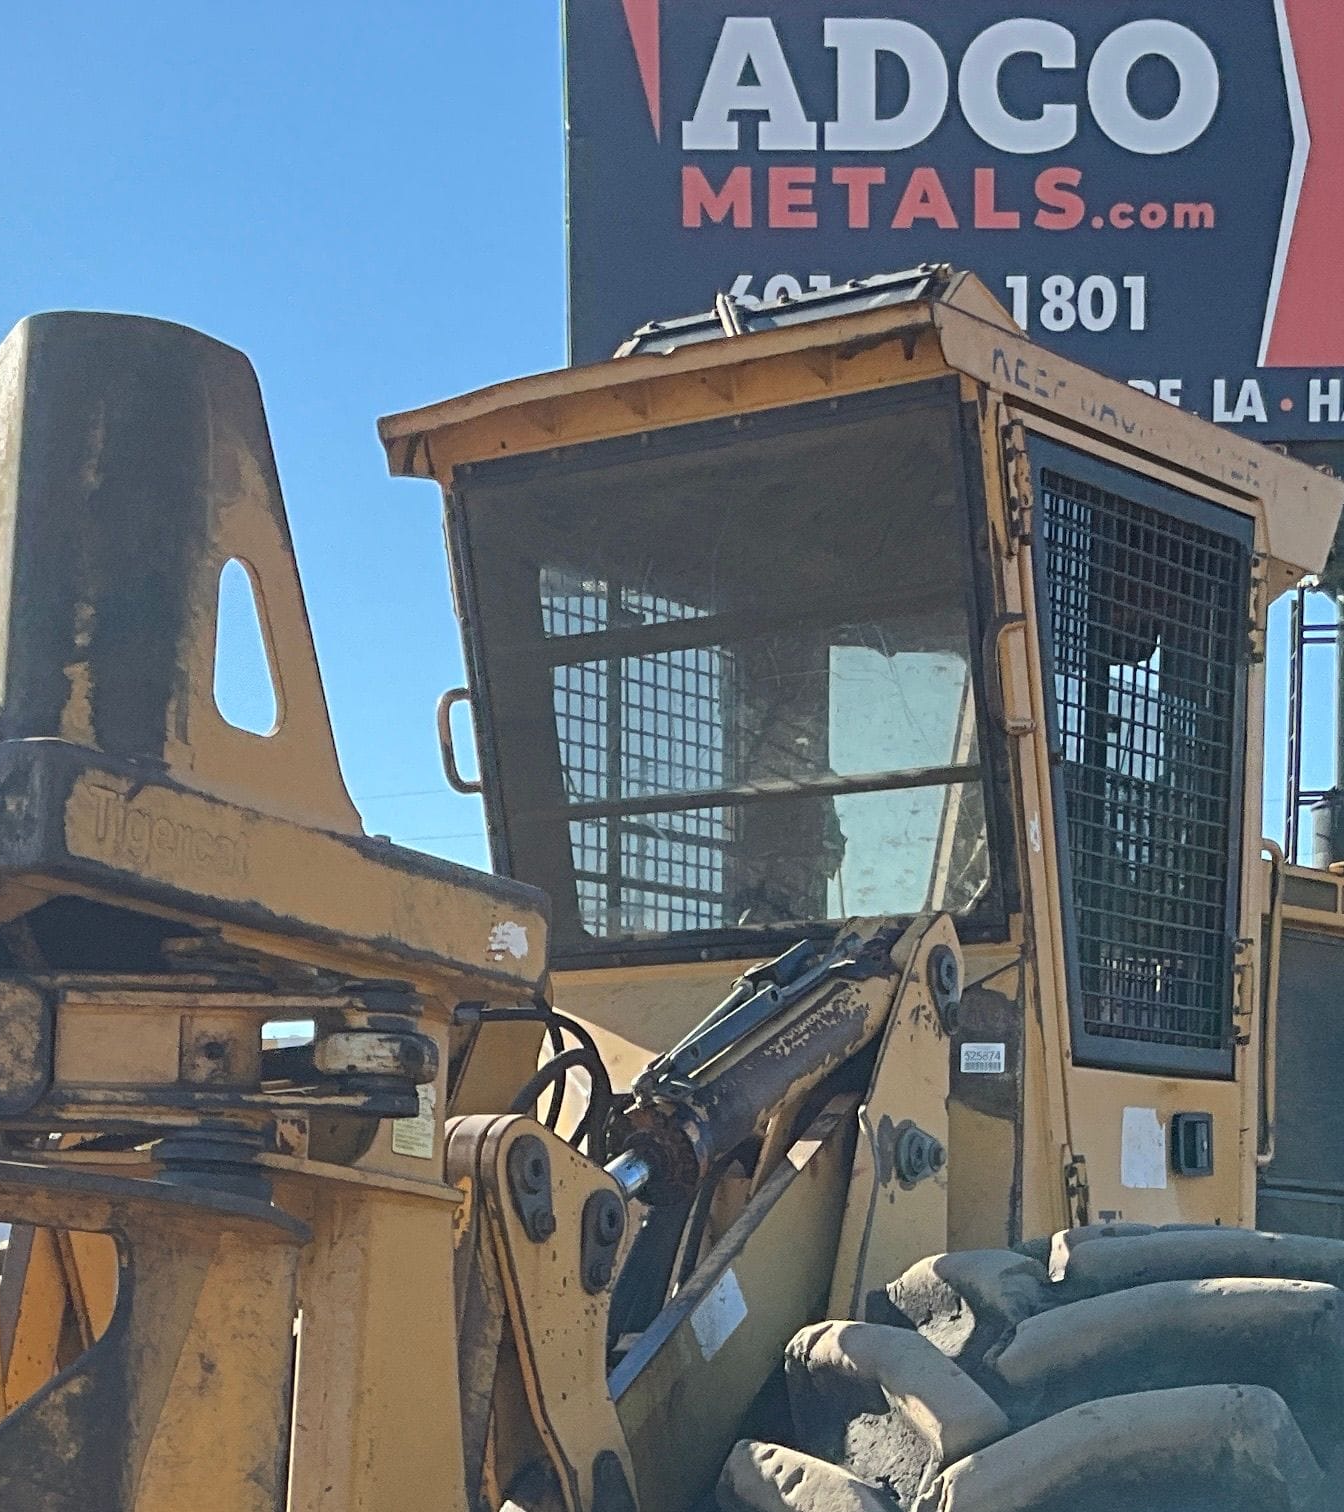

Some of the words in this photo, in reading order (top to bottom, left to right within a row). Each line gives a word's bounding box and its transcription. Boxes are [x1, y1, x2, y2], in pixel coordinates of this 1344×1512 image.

[681, 16, 1221, 155] ADCO
[681, 165, 1216, 230] METALS.com
[1005, 274, 1145, 332] 1801
[1212, 378, 1268, 423] LA
